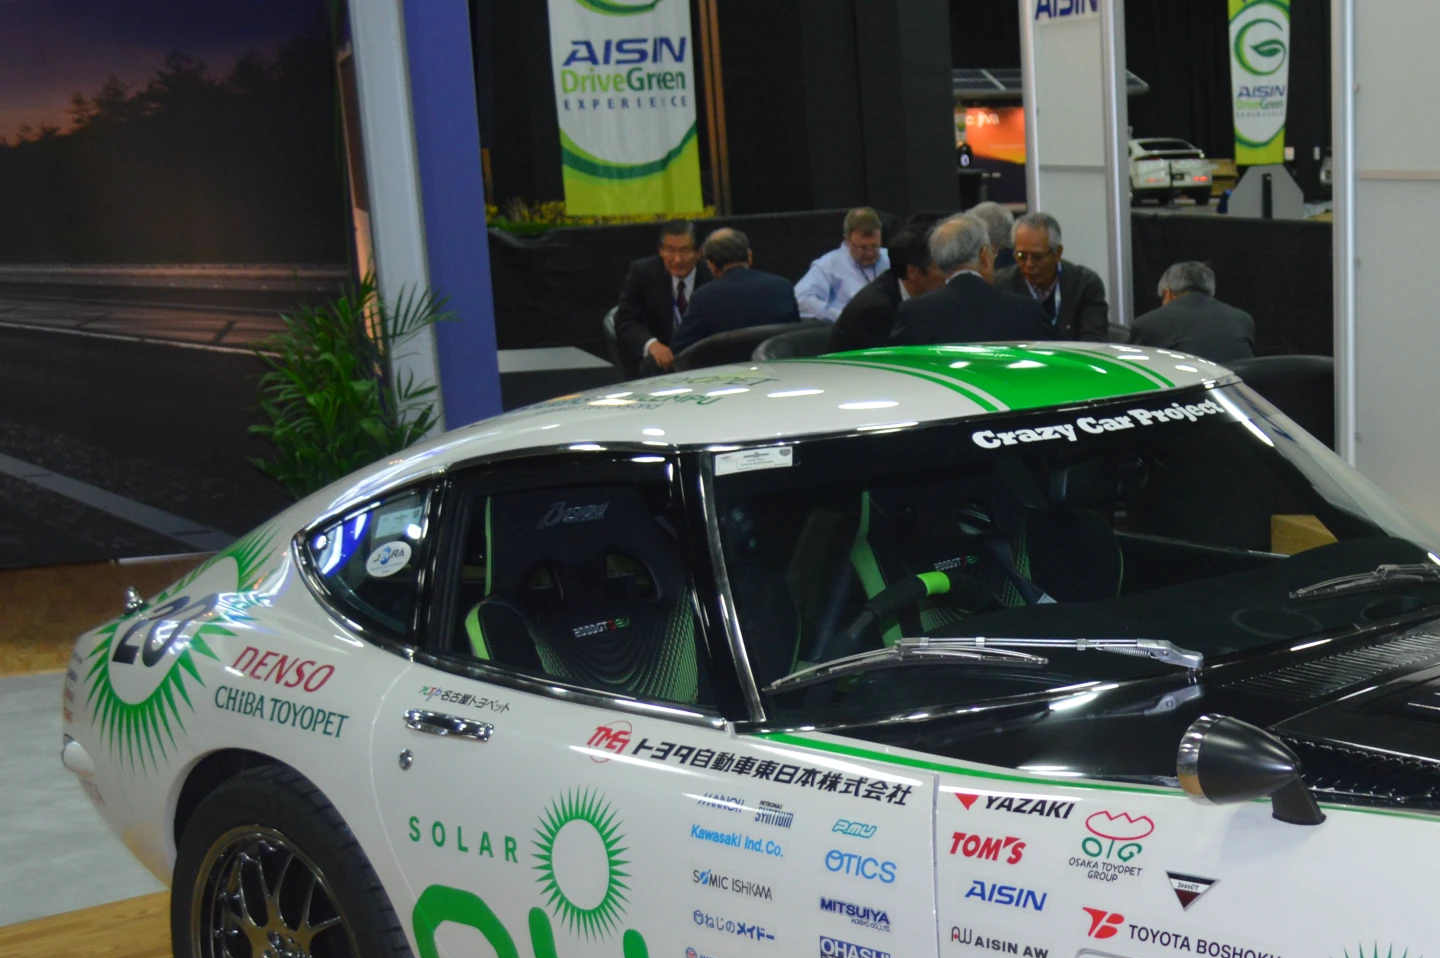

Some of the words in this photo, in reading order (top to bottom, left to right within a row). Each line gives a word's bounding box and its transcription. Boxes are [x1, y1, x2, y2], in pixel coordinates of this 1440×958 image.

[562, 37, 687, 66] AISIN
[564, 96, 688, 110] EXPERIECE
[1237, 85, 1286, 98] AISIN
[972, 424, 1077, 449] Crazy
[1077, 416, 1133, 434] Car
[1129, 398, 1226, 426] Project
[231, 646, 336, 692] DENSO
[441, 690, 511, 713] 名古屋トヨペット
[268, 697, 349, 738] TOYOPET
[632, 738, 914, 806] トヨタ自動車東日本株式会社
[985, 796, 1076, 819] YAZAKI
[408, 815, 519, 863] SOLAR
[690, 823, 743, 848] Kawasaki
[744, 835, 763, 853] Ind.
[765, 840, 784, 858] Co.
[950, 831, 1027, 865] TOM'S
[825, 850, 897, 884] OTICS
[1069, 857, 1099, 870] OSAKA
[1101, 862, 1142, 877] TOYOPET
[1087, 870, 1118, 882] GROUP
[965, 880, 1047, 911] AISIN
[1177, 880, 1199, 891] 2000GT
[821, 897, 890, 924] MITSUIYA
[704, 913, 775, 941] ねじのメイドー
[1128, 924, 1192, 951] TOYOTA
[974, 936, 1019, 955] AISIN
